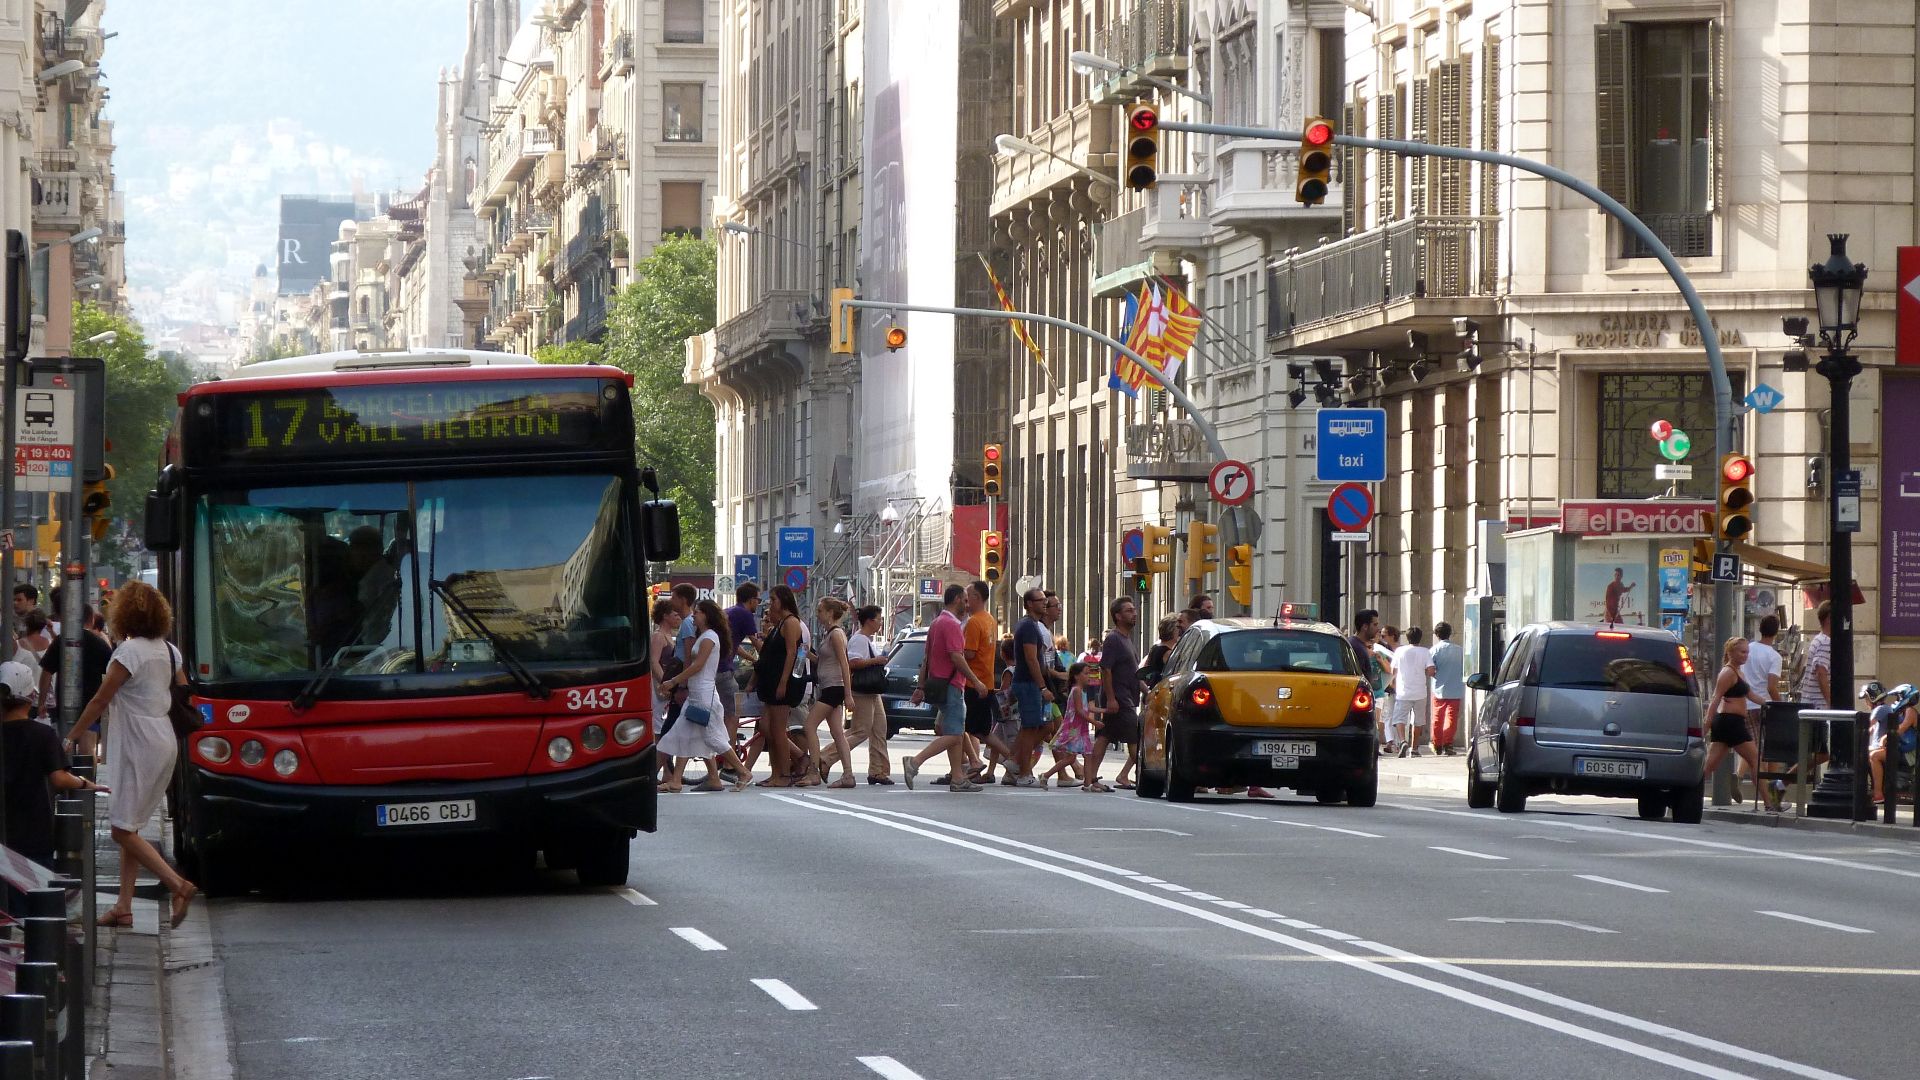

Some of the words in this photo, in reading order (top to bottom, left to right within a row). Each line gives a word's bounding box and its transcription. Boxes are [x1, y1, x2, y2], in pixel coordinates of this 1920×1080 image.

[281, 239, 309, 264] R
[1600, 313, 1671, 331] CAMBRA
[1575, 331, 1662, 348] PROPIETAT
[1752, 391, 1774, 406] W
[246, 399, 307, 448] 17
[318, 421, 407, 444] VALL
[422, 413, 560, 440] HEBRON
[31, 448, 43, 458] 19
[51, 449, 65, 459] 40
[1339, 453, 1364, 467] taxi
[28, 463, 44, 472] 120
[1589, 508, 1612, 532] el
[1616, 508, 1706, 532] Periódi
[741, 557, 752, 570] P
[790, 551, 803, 559] taxi
[1720, 557, 1733, 577] P
[566, 687, 628, 710] 3437
[1263, 743, 1287, 754] 1994
[1291, 743, 1311, 755] FHG
[1586, 761, 1614, 773] 6036
[1618, 763, 1639, 775] GTY
[389, 805, 430, 823] 0466
[440, 803, 472, 820] CBJ
